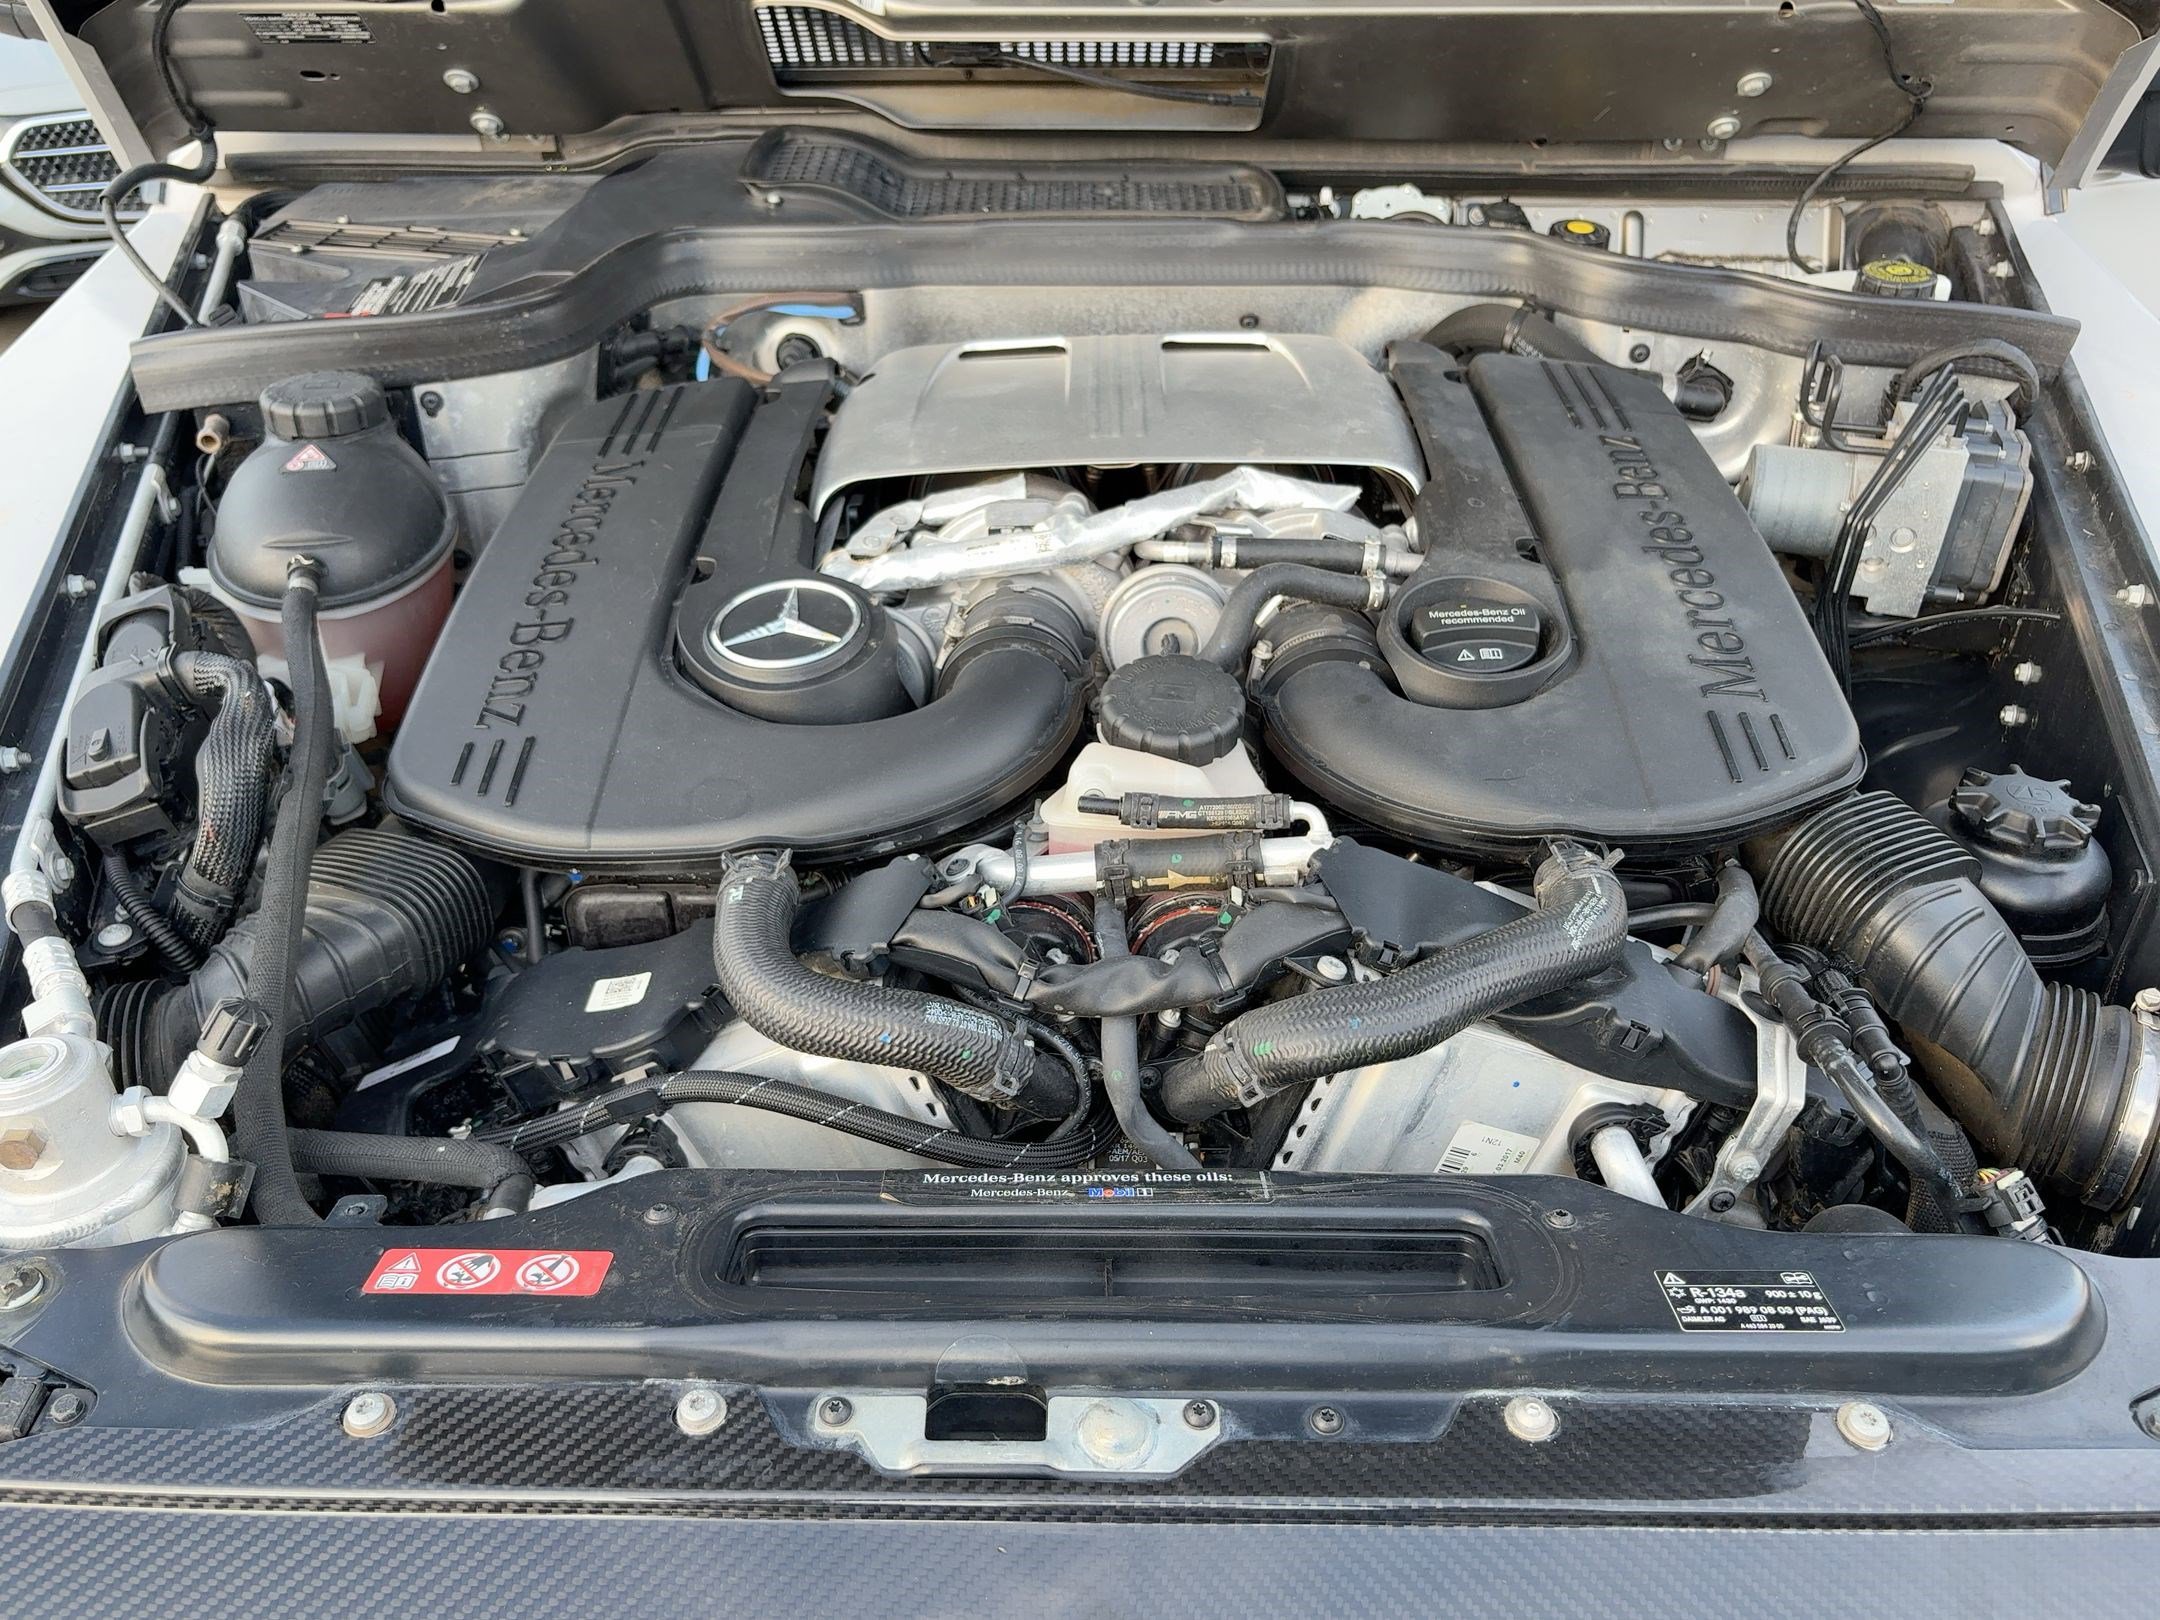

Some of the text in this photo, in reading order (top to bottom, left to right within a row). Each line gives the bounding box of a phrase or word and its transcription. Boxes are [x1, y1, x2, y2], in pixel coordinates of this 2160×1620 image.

[1599, 434, 1768, 702] Mercedes-Benz
[473, 459, 646, 729] Mercedes-Benz
[1428, 607, 1526, 619] Mercedes-Benz Oil
[1440, 615, 1515, 625] recommended
[922, 1171, 1233, 1185] Mercedes-Benz approves these oils:
[970, 1188, 1069, 1197] Mercedes-Benz
[1088, 1187, 1135, 1198] Mobil
[1689, 1287, 1747, 1298] R-134a
[1764, 1289, 1788, 1299] 900
[1797, 1289, 1813, 1299] 10
[1700, 1305, 1710, 1314] A
[1710, 1305, 1733, 1314] 001
[1734, 1305, 1758, 1314] 989
[1794, 1305, 1829, 1317] (PAG)
